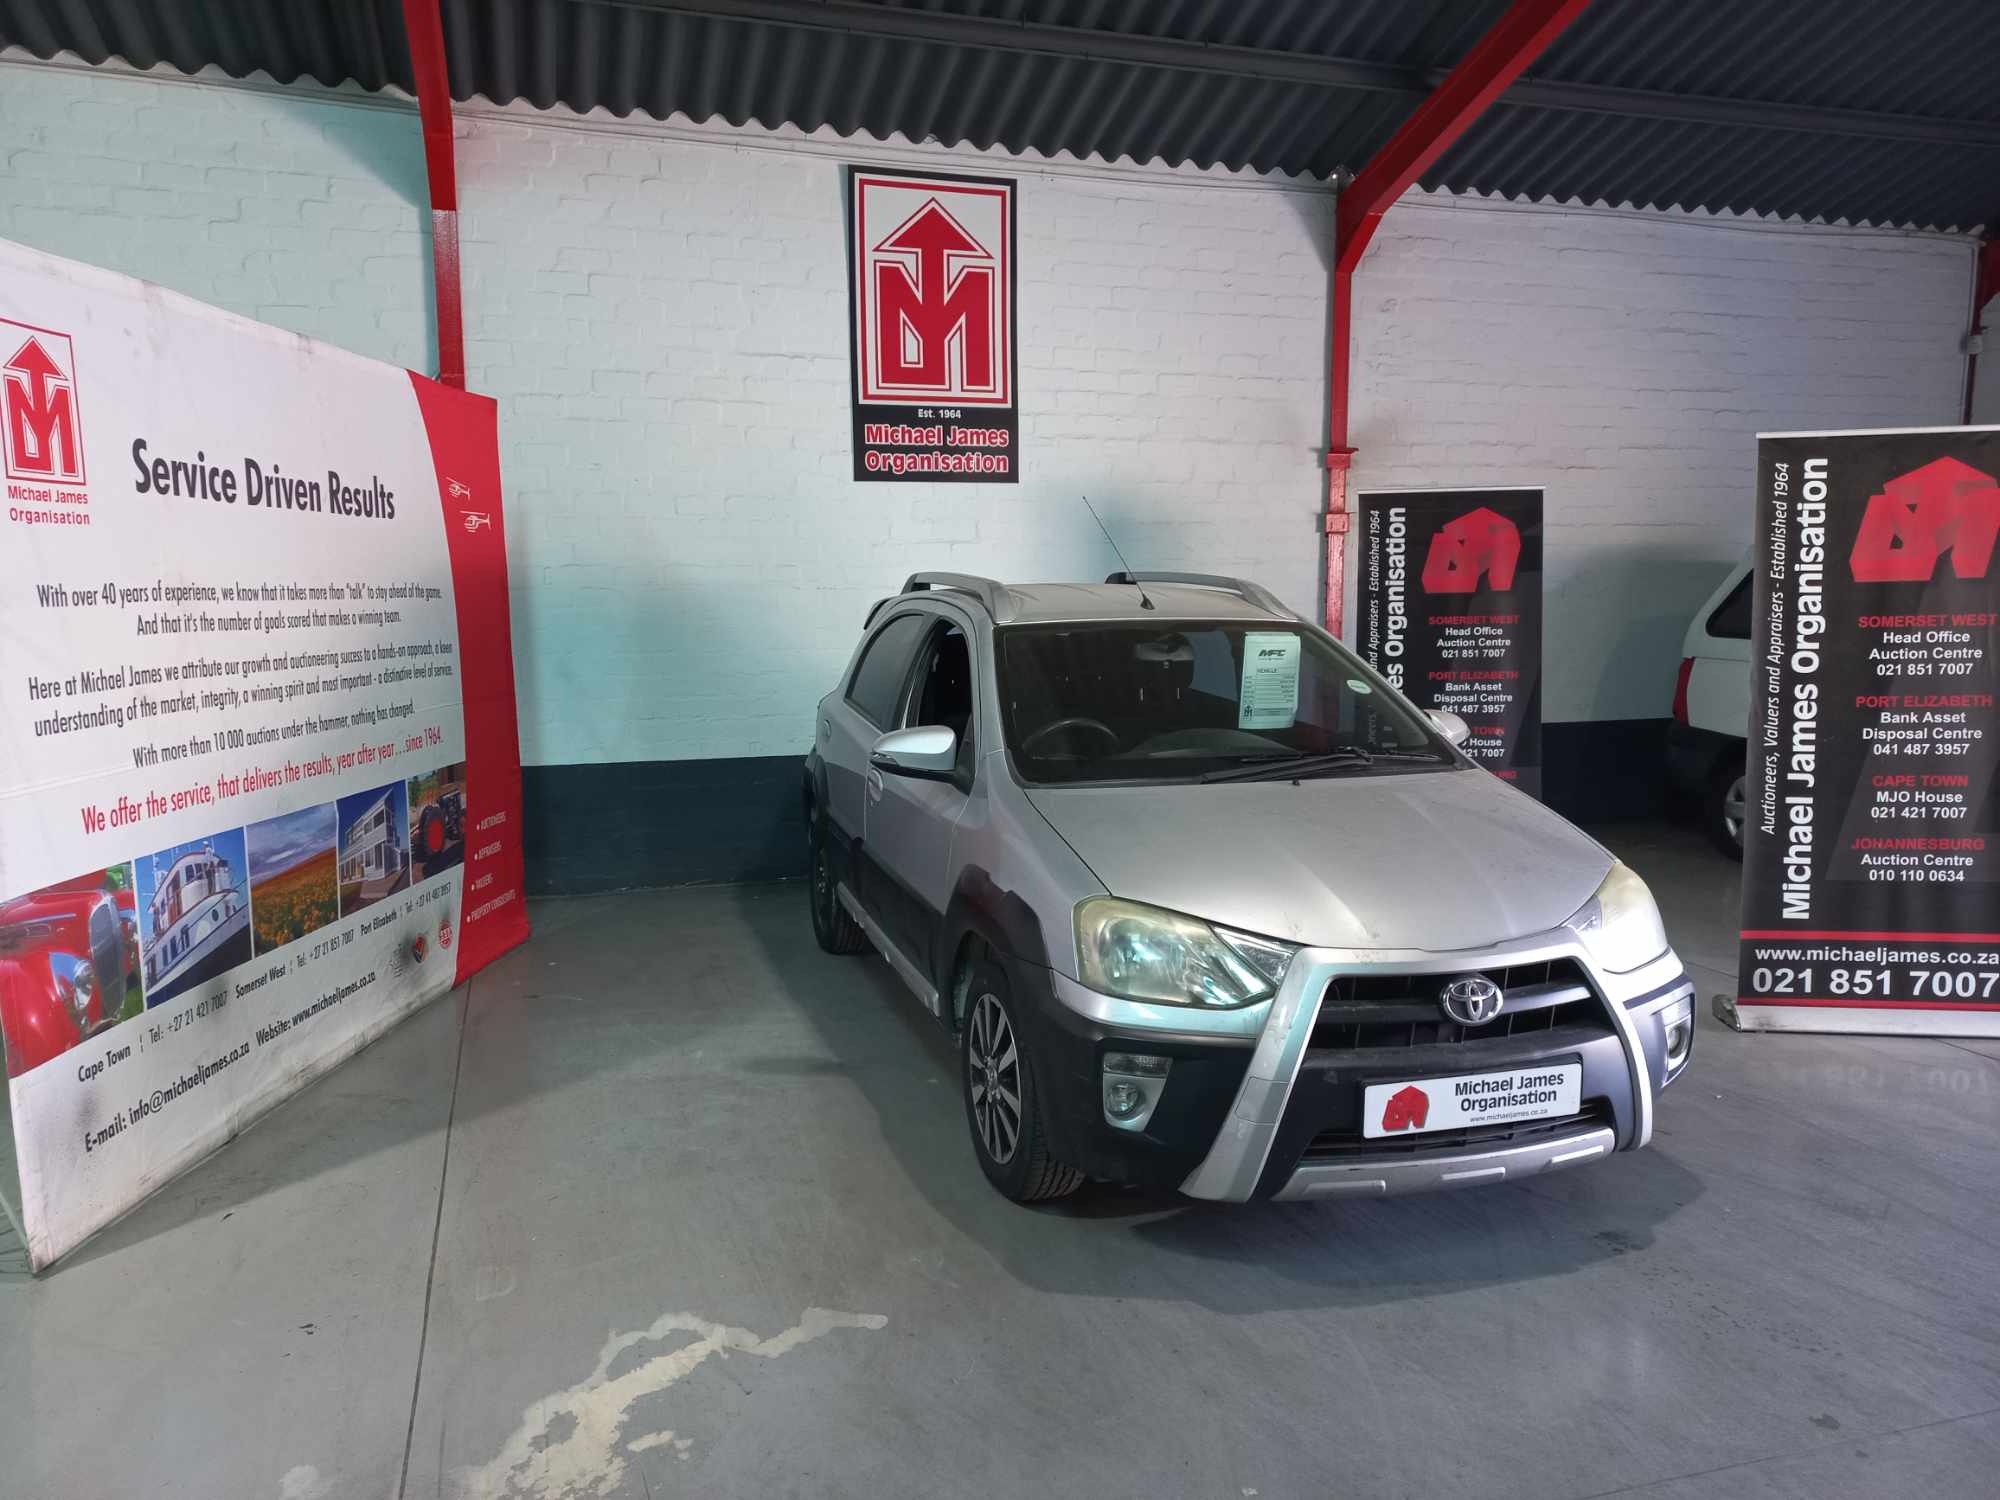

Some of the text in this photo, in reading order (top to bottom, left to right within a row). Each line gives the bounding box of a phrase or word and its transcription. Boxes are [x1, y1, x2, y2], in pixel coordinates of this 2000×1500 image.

[918, 409, 961, 418] Est. 1964
[865, 424, 1008, 446] Michael James
[865, 451, 1008, 474] Organisation
[132, 437, 395, 520] Service Driven Results
[8, 485, 88, 504] Michael James
[10, 508, 90, 524] Organisation
[1368, 510, 1380, 649] Appraisers Established 1964
[1385, 507, 1407, 657] Organisation
[37, 579, 344, 608] With over 40 years of experience, we know that takes more than
[137, 608, 350, 635] And that it's the number of goals scored that makes
[1858, 613, 1997, 628] SOMERSET WEST
[1446, 627, 1502, 636] Head Office
[1883, 631, 1970, 643] Head Office
[1437, 638, 1511, 647] Auction Centre
[1761, 463, 1789, 835] Auctioneers, Valuers and Appraisers Established 1964
[1442, 650, 1458, 658] 021
[1483, 649, 1506, 657] 7007
[1869, 648, 1982, 659] Auction Centre
[29, 645, 363, 700] Here at Michael James we attribute our growth and auctioneering success
[1877, 664, 1973, 675] 021 851 7007
[1446, 683, 1470, 691] Bank
[1782, 459, 1828, 919] Michael James Organisation
[35, 672, 372, 736] understanding of the market, integrity, winning spirit and most important
[1434, 694, 1512, 703] Disposal Centre
[1856, 695, 1992, 708] PORT ELIZABETH
[1881, 712, 1966, 723] Bank Asset
[133, 708, 375, 768] With more than 10 000 auctions under the hammer, nothing
[1863, 728, 1982, 741] Disposal Centre
[1482, 749, 1505, 757] 7007
[1874, 744, 1970, 754] 041 487 3957
[82, 744, 375, 834] We offer the service, that delivers the results, year after
[1872, 776, 1968, 788] CAPE TOWN
[1876, 792, 1963, 802] MJO House
[1871, 807, 1967, 818] 021 421 7007
[1852, 838, 1984, 849] JOHANNESBURG
[1861, 854, 1973, 865] Auction Centre
[1869, 870, 1964, 881] 010 110 0634
[1755, 947, 1999, 965] www.michaeljames.co.za
[236, 964, 285, 998] Somerset West
[1753, 968, 2000, 997] 021 851 7007
[256, 970, 376, 1046] Website: www.michaeljames.co.za
[79, 1045, 131, 1082] Cape Town
[1455, 1073, 1563, 1096] Michael James
[85, 1041, 249, 1152] E-mail: info@michaeljames.co.za
[1461, 1090, 1557, 1112] Organisation
[1470, 1109, 1548, 1123] www.michaeljames.co.za
